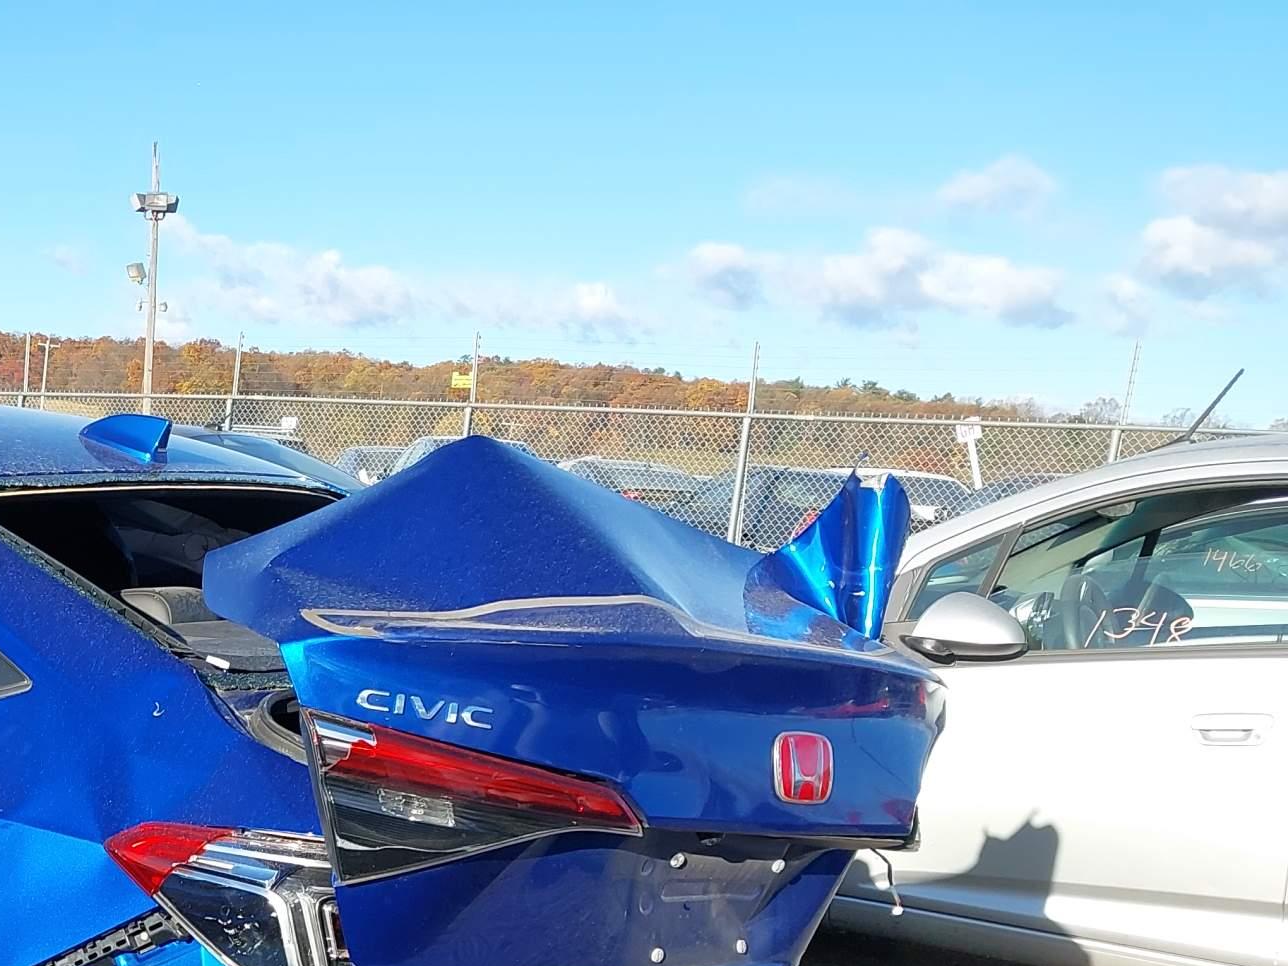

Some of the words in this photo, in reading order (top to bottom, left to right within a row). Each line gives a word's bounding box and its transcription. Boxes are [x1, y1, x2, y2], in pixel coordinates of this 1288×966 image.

[1203, 547, 1262, 573] 1466
[1084, 607, 1194, 648] 1348
[355, 689, 494, 730] CIVIC
